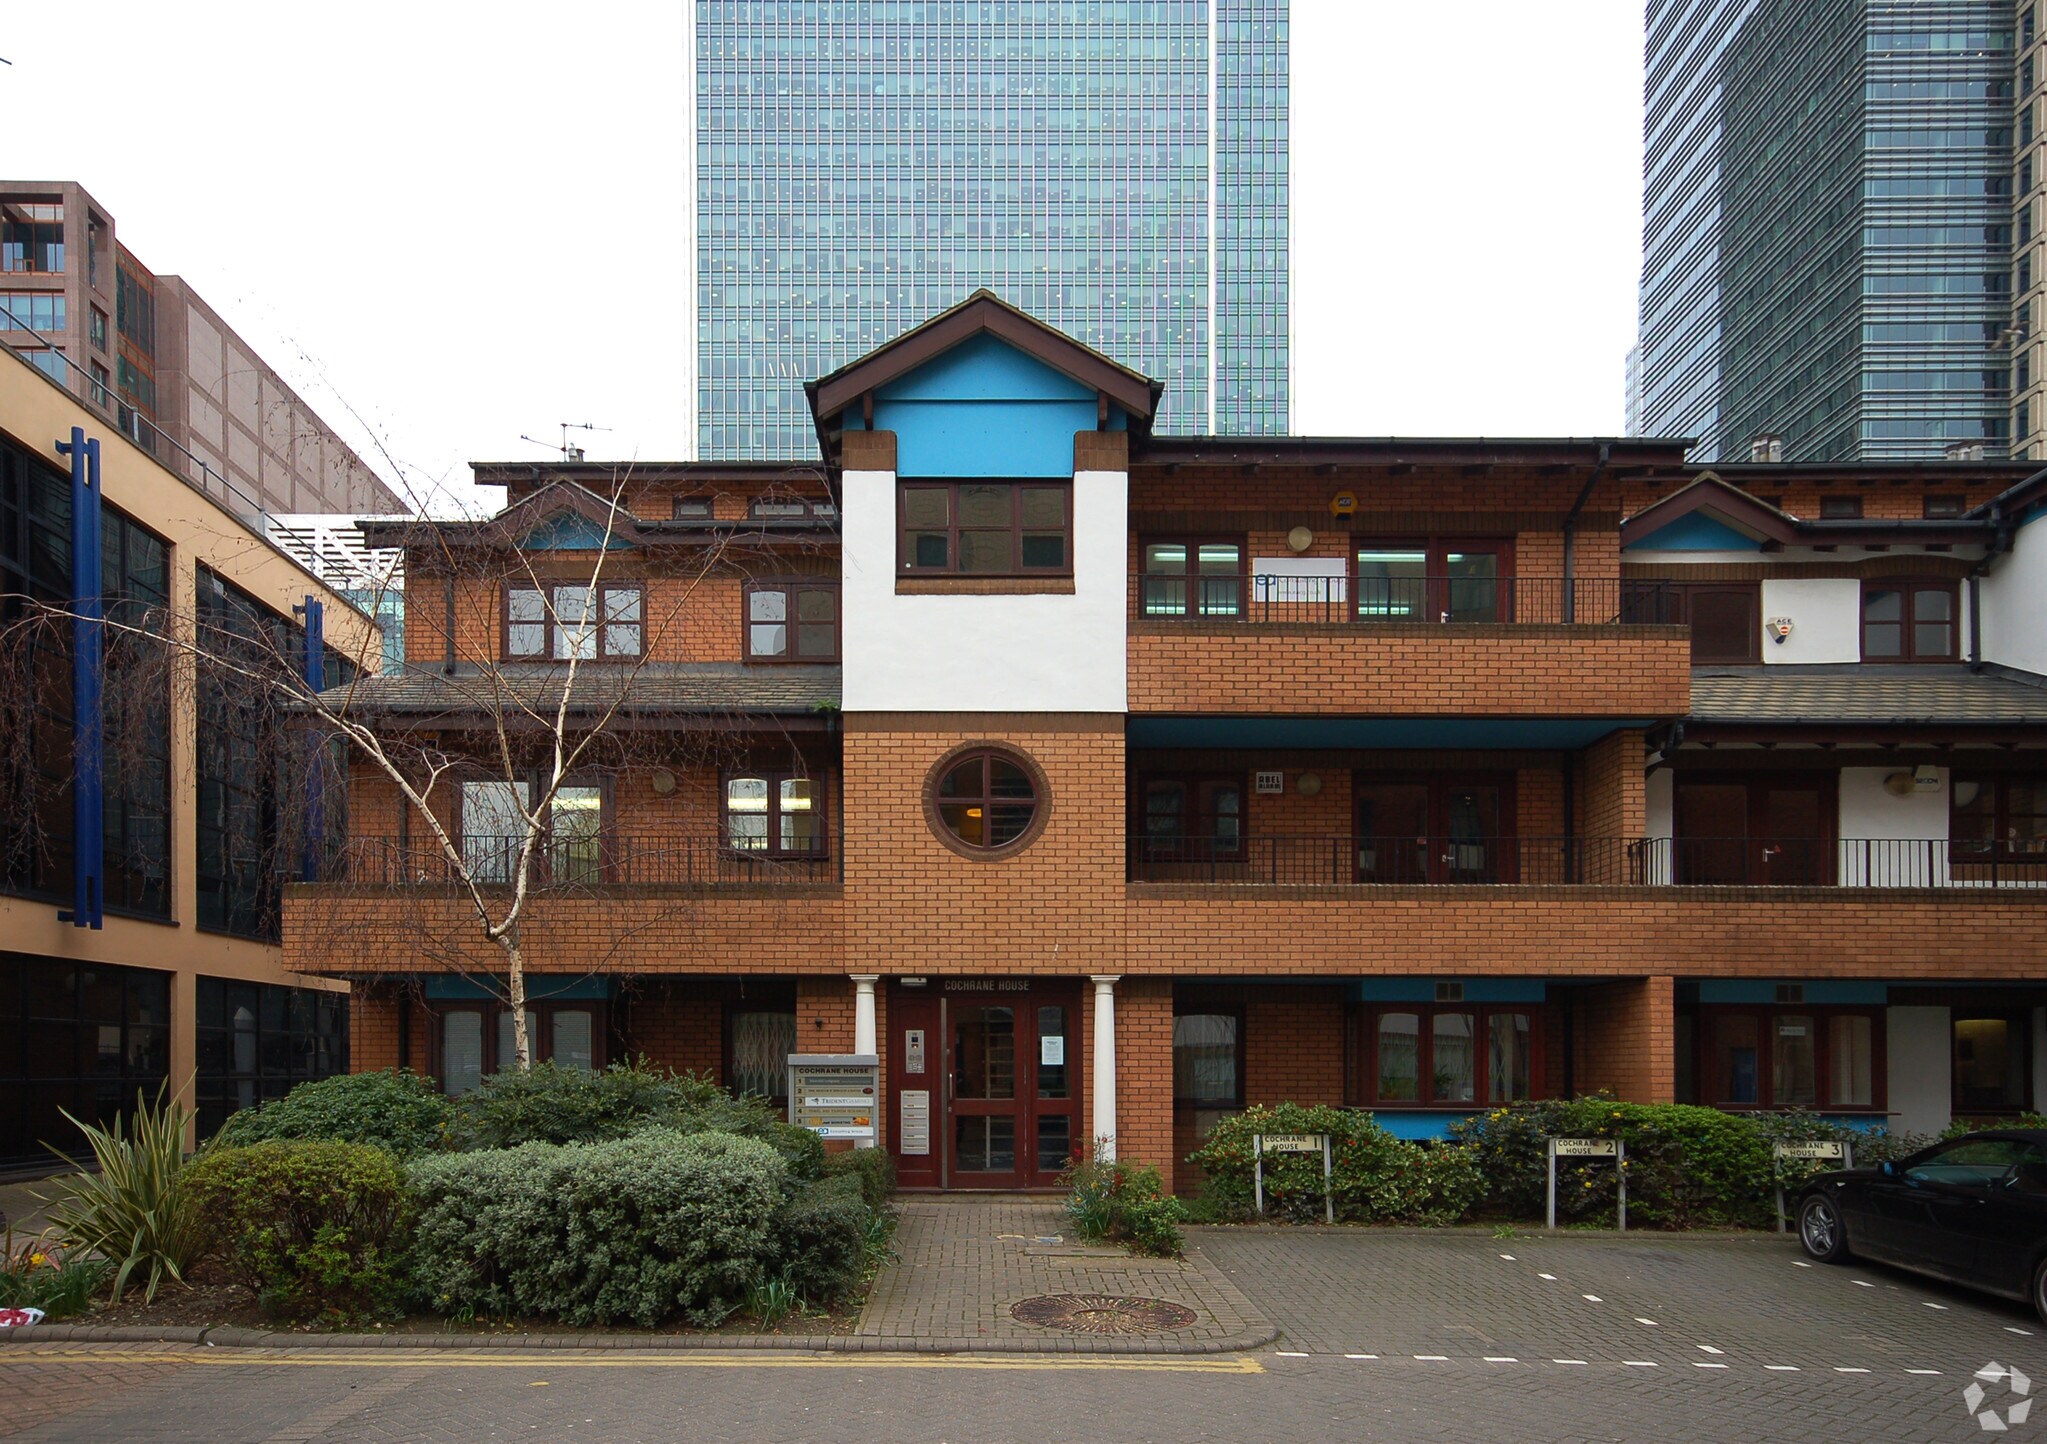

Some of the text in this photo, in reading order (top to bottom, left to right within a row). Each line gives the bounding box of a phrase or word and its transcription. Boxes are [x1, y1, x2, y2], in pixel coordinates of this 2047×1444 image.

[944, 979, 1030, 991] COCHRANE HOUSE
[1605, 1141, 1614, 1153] 2
[1831, 1144, 1840, 1156] 3
